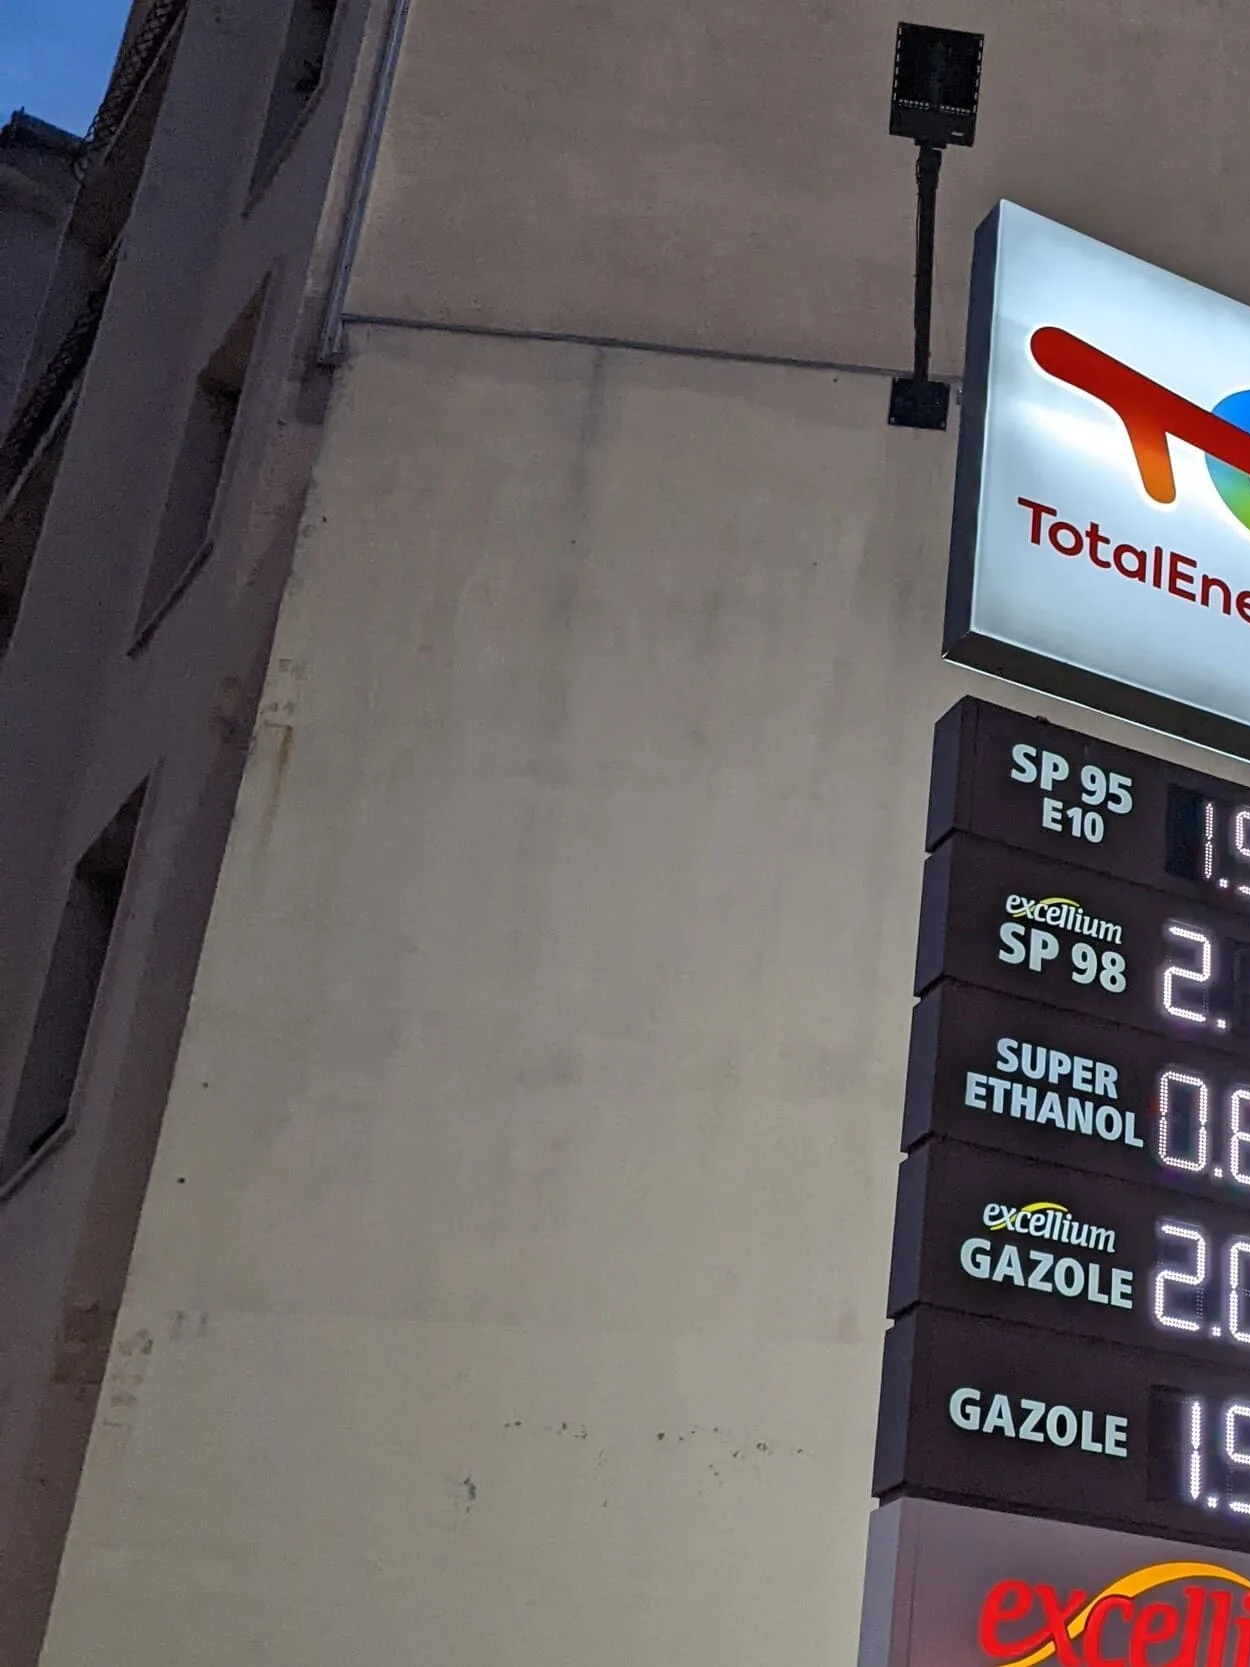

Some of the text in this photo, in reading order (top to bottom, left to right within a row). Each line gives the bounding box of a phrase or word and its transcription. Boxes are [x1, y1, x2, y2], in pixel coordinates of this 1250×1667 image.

[1010, 743, 1134, 815] SP 95
[1041, 798, 1106, 844] E10
[1005, 894, 1123, 945] excellium
[999, 926, 1128, 994] SP 98
[996, 1037, 1119, 1100] SUPER
[964, 1071, 1145, 1149] ETHANOL
[982, 1202, 1116, 1254] excellium
[960, 1237, 1134, 1310] GAZOLE
[948, 1387, 1129, 1458] GAZOLE
